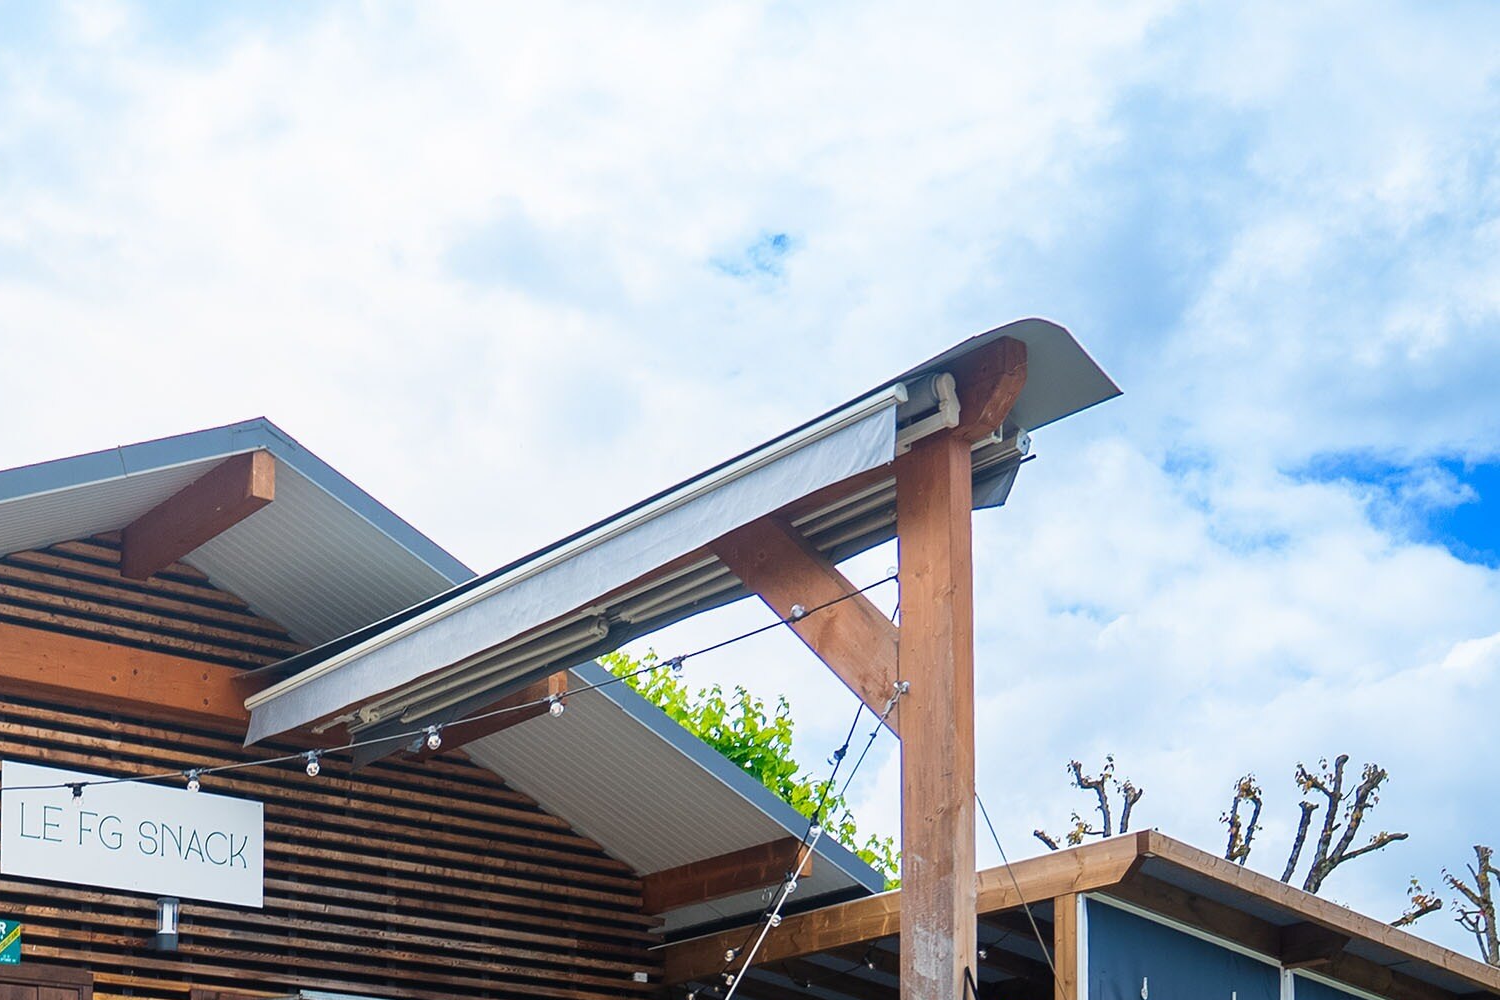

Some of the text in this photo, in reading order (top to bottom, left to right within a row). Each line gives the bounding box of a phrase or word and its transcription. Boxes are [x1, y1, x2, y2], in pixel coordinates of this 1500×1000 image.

[20, 802, 249, 869] LE FG SNACK
